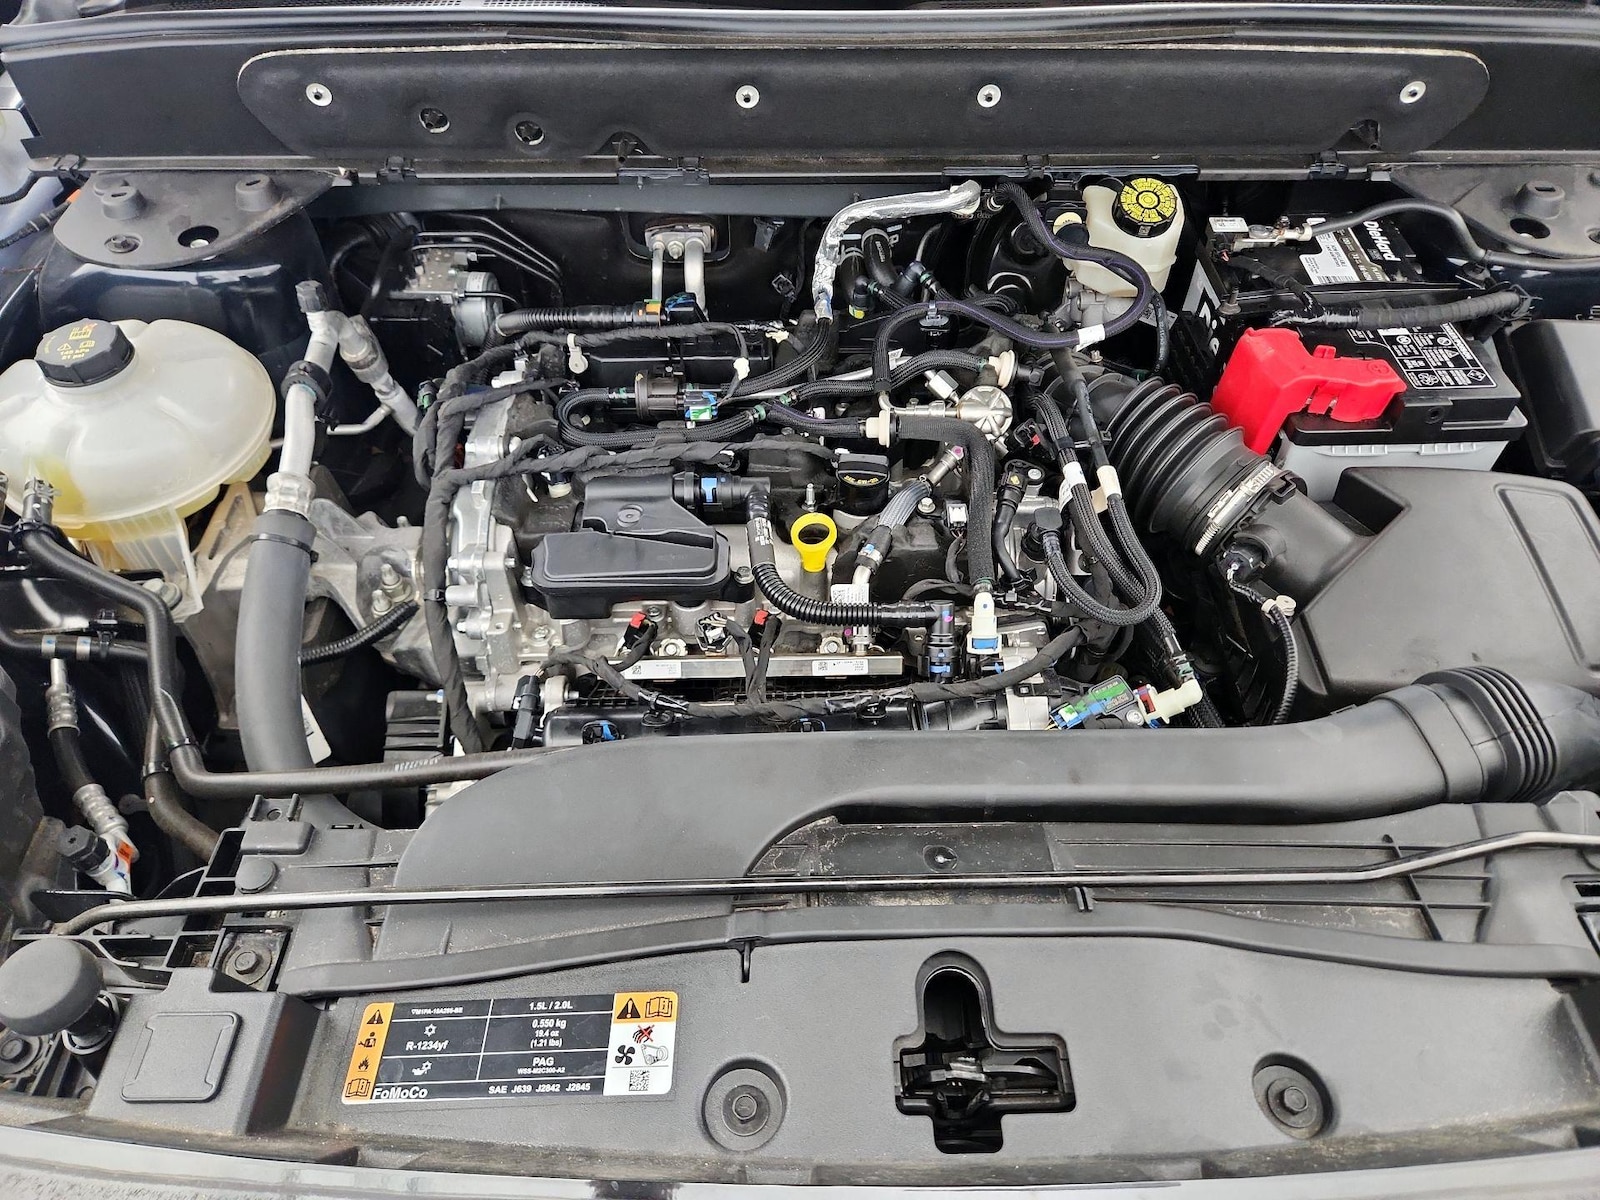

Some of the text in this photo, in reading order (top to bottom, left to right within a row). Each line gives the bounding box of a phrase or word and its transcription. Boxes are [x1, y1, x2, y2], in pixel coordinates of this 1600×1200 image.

[1363, 220, 1401, 262] DieHard
[529, 1001, 548, 1010] 1.5L
[554, 1000, 573, 1009] 2.0L
[532, 1018, 567, 1029] 0.550 kg
[535, 1029, 549, 1037] 19.4
[405, 1040, 450, 1051] R-1234yf
[530, 1038, 563, 1048] (1.21 lbs)
[532, 1056, 555, 1067] PAG
[372, 1086, 429, 1099] FoMoCo
[488, 1082, 591, 1094] SAE J639 J2842 J2845
